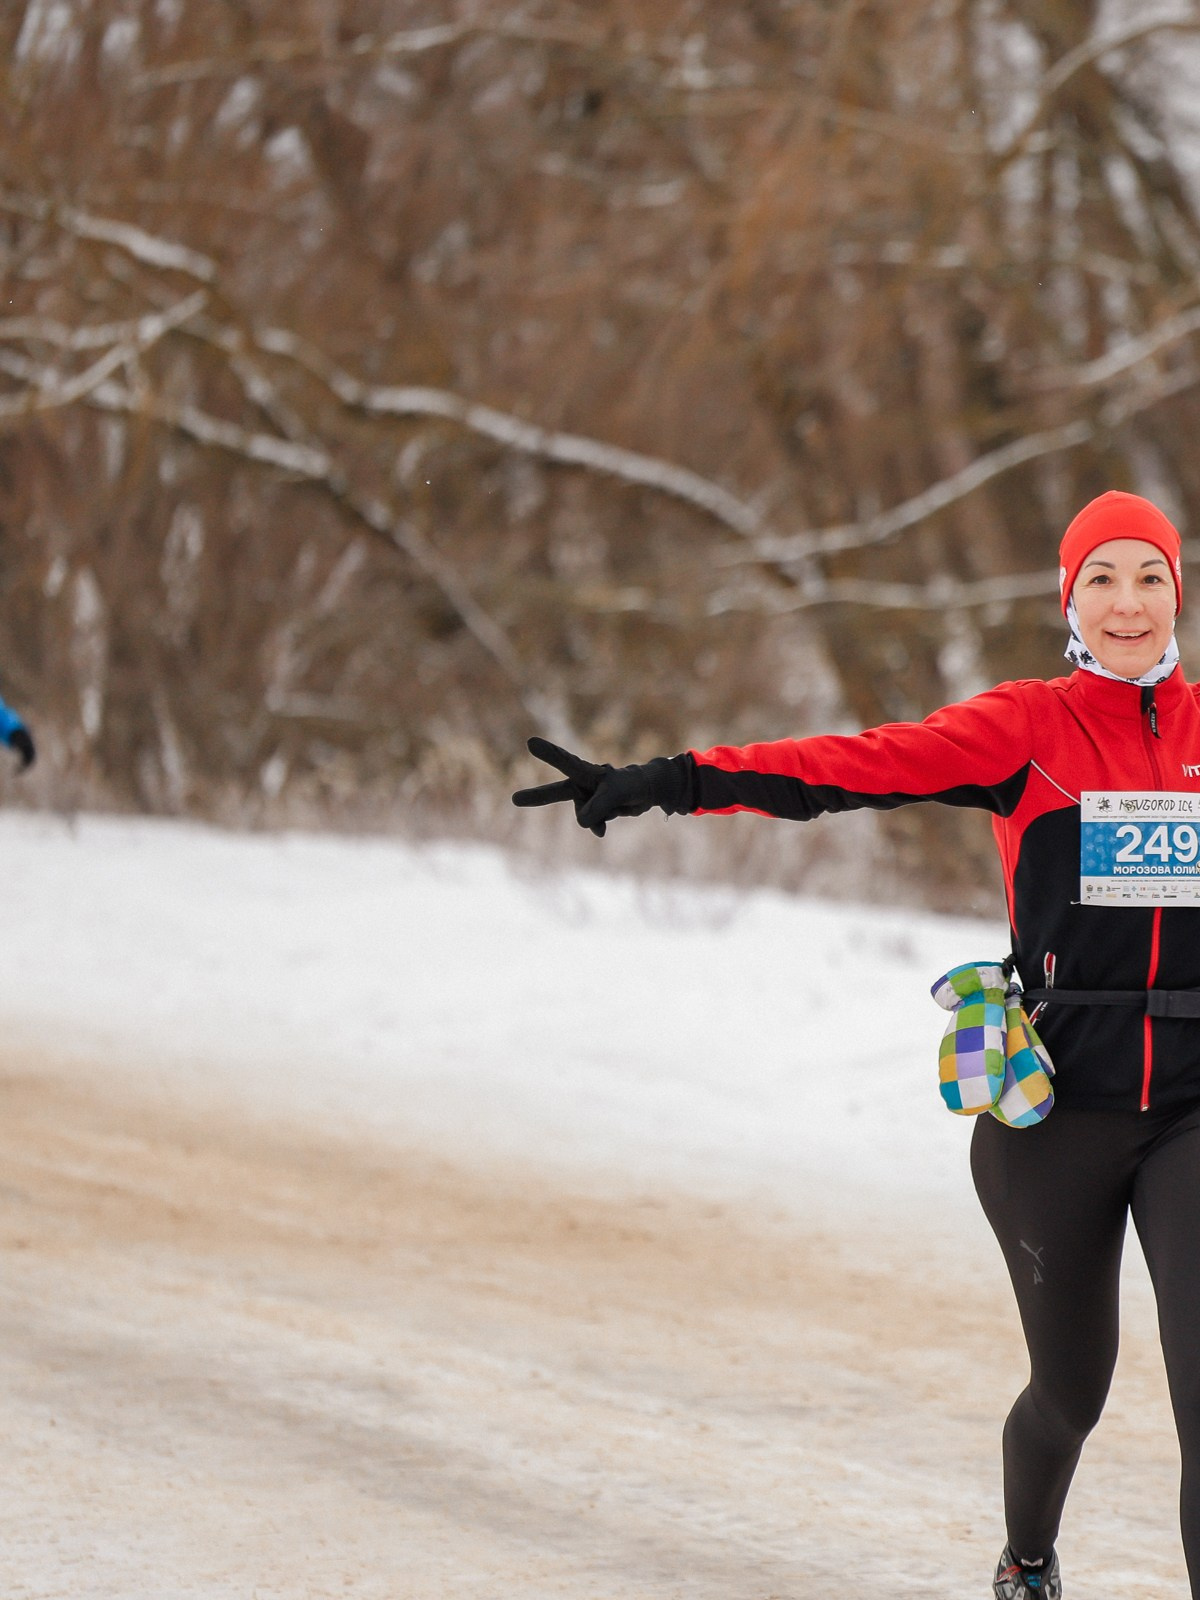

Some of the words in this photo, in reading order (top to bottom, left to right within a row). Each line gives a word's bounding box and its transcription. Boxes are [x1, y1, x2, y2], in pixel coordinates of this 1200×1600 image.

[1119, 799, 1175, 811] NVGOROD
[1178, 800, 1192, 813] ICE
[1116, 825, 1198, 862] 249
[1113, 866, 1171, 875] МОРОЗОВА
[1172, 865, 1199, 875] ЮЛИ
